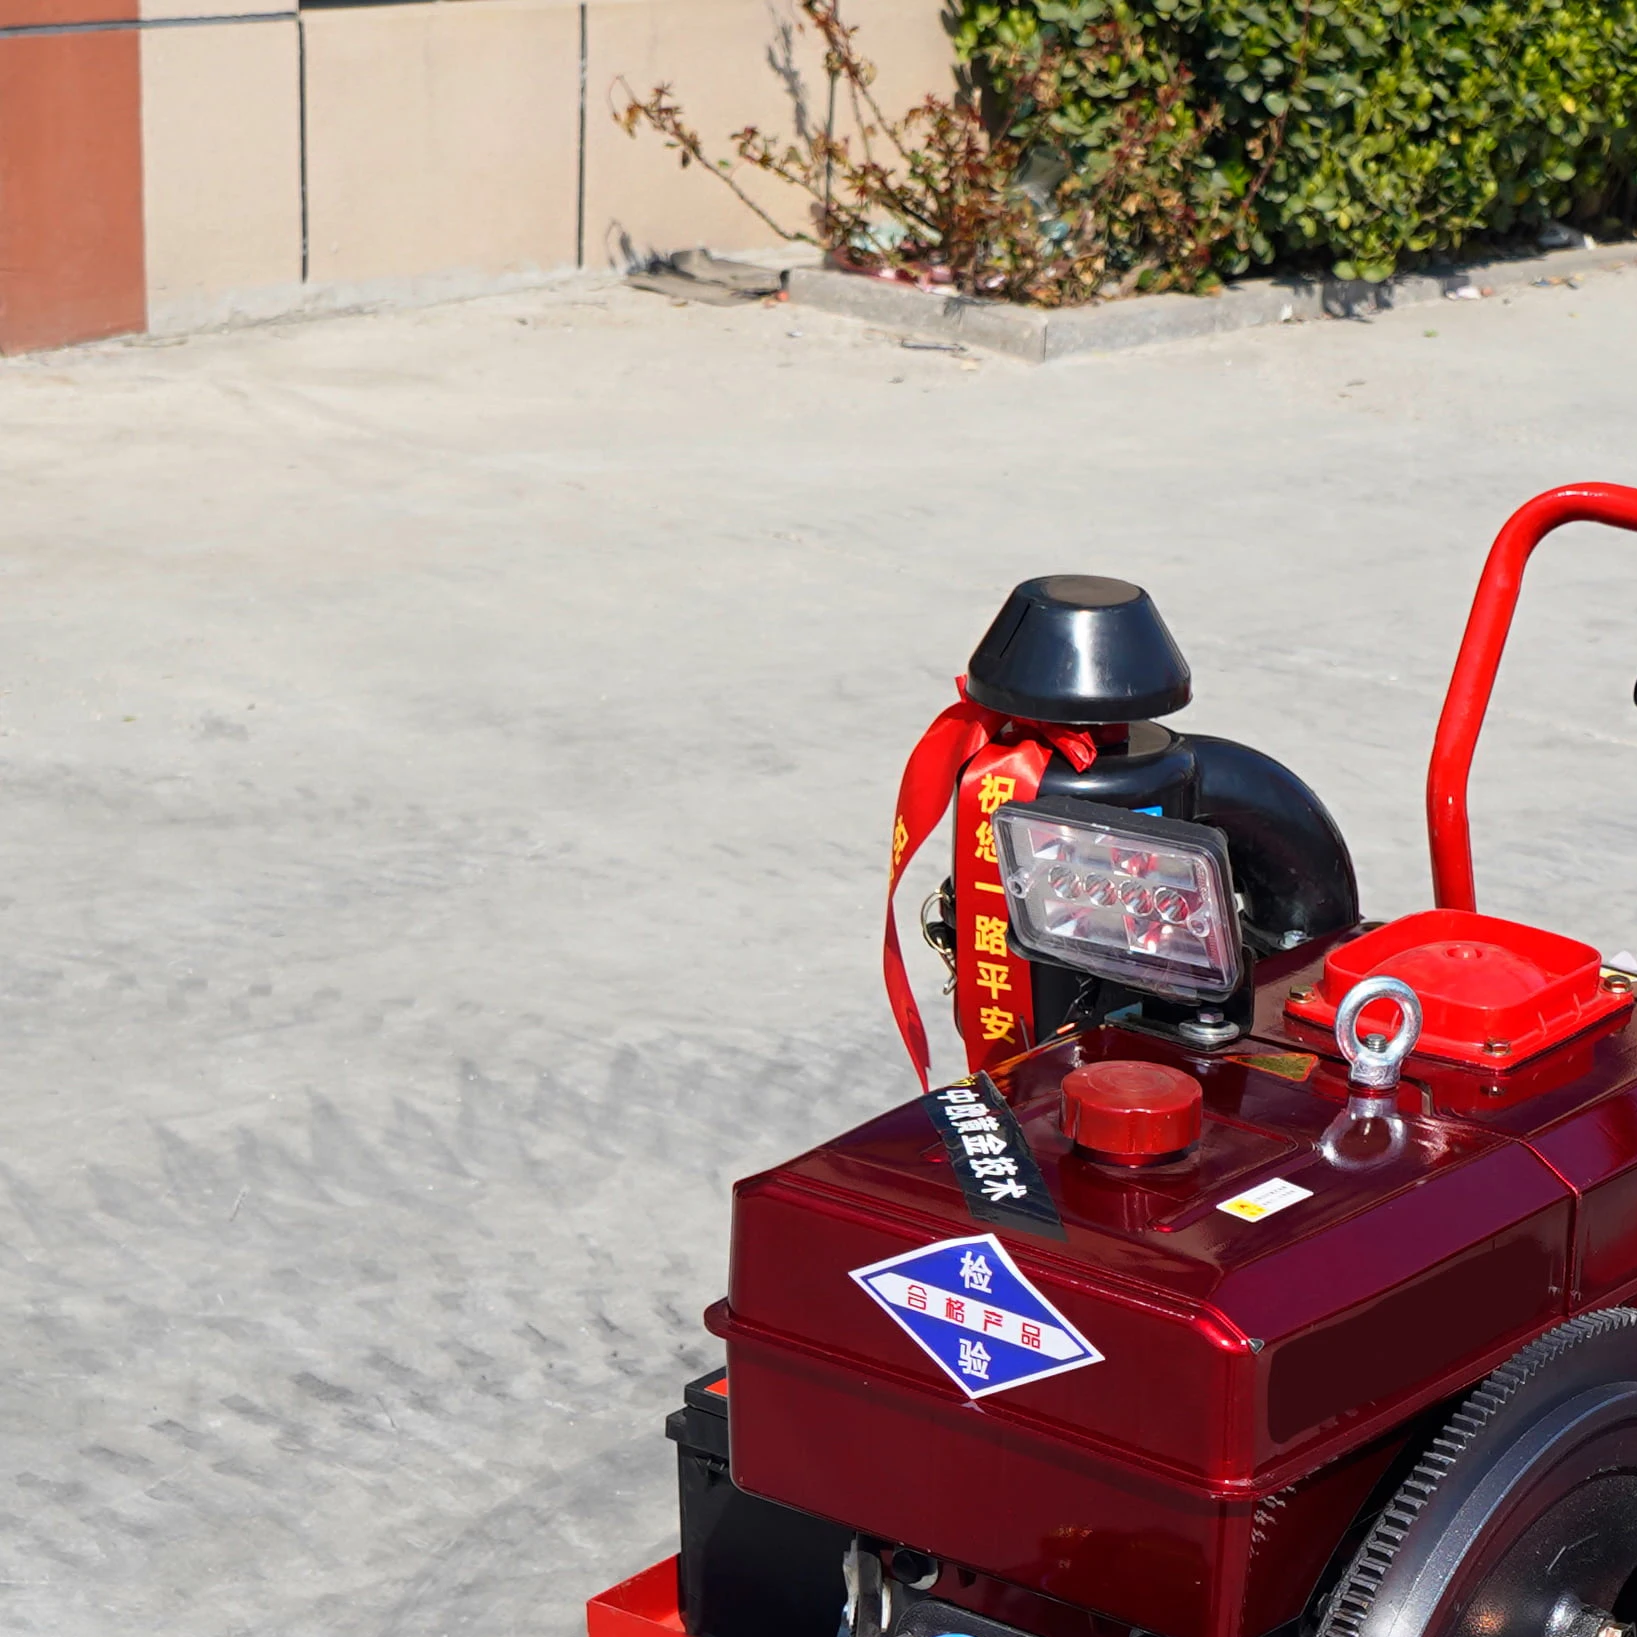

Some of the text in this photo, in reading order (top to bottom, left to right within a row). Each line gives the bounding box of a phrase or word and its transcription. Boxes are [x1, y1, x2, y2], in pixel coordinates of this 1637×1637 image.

[936, 1088, 1028, 1202] 中欧黄金技术
[959, 1250, 993, 1294] 检
[907, 1284, 1041, 1350] 合格产品
[957, 1338, 992, 1381] 验
